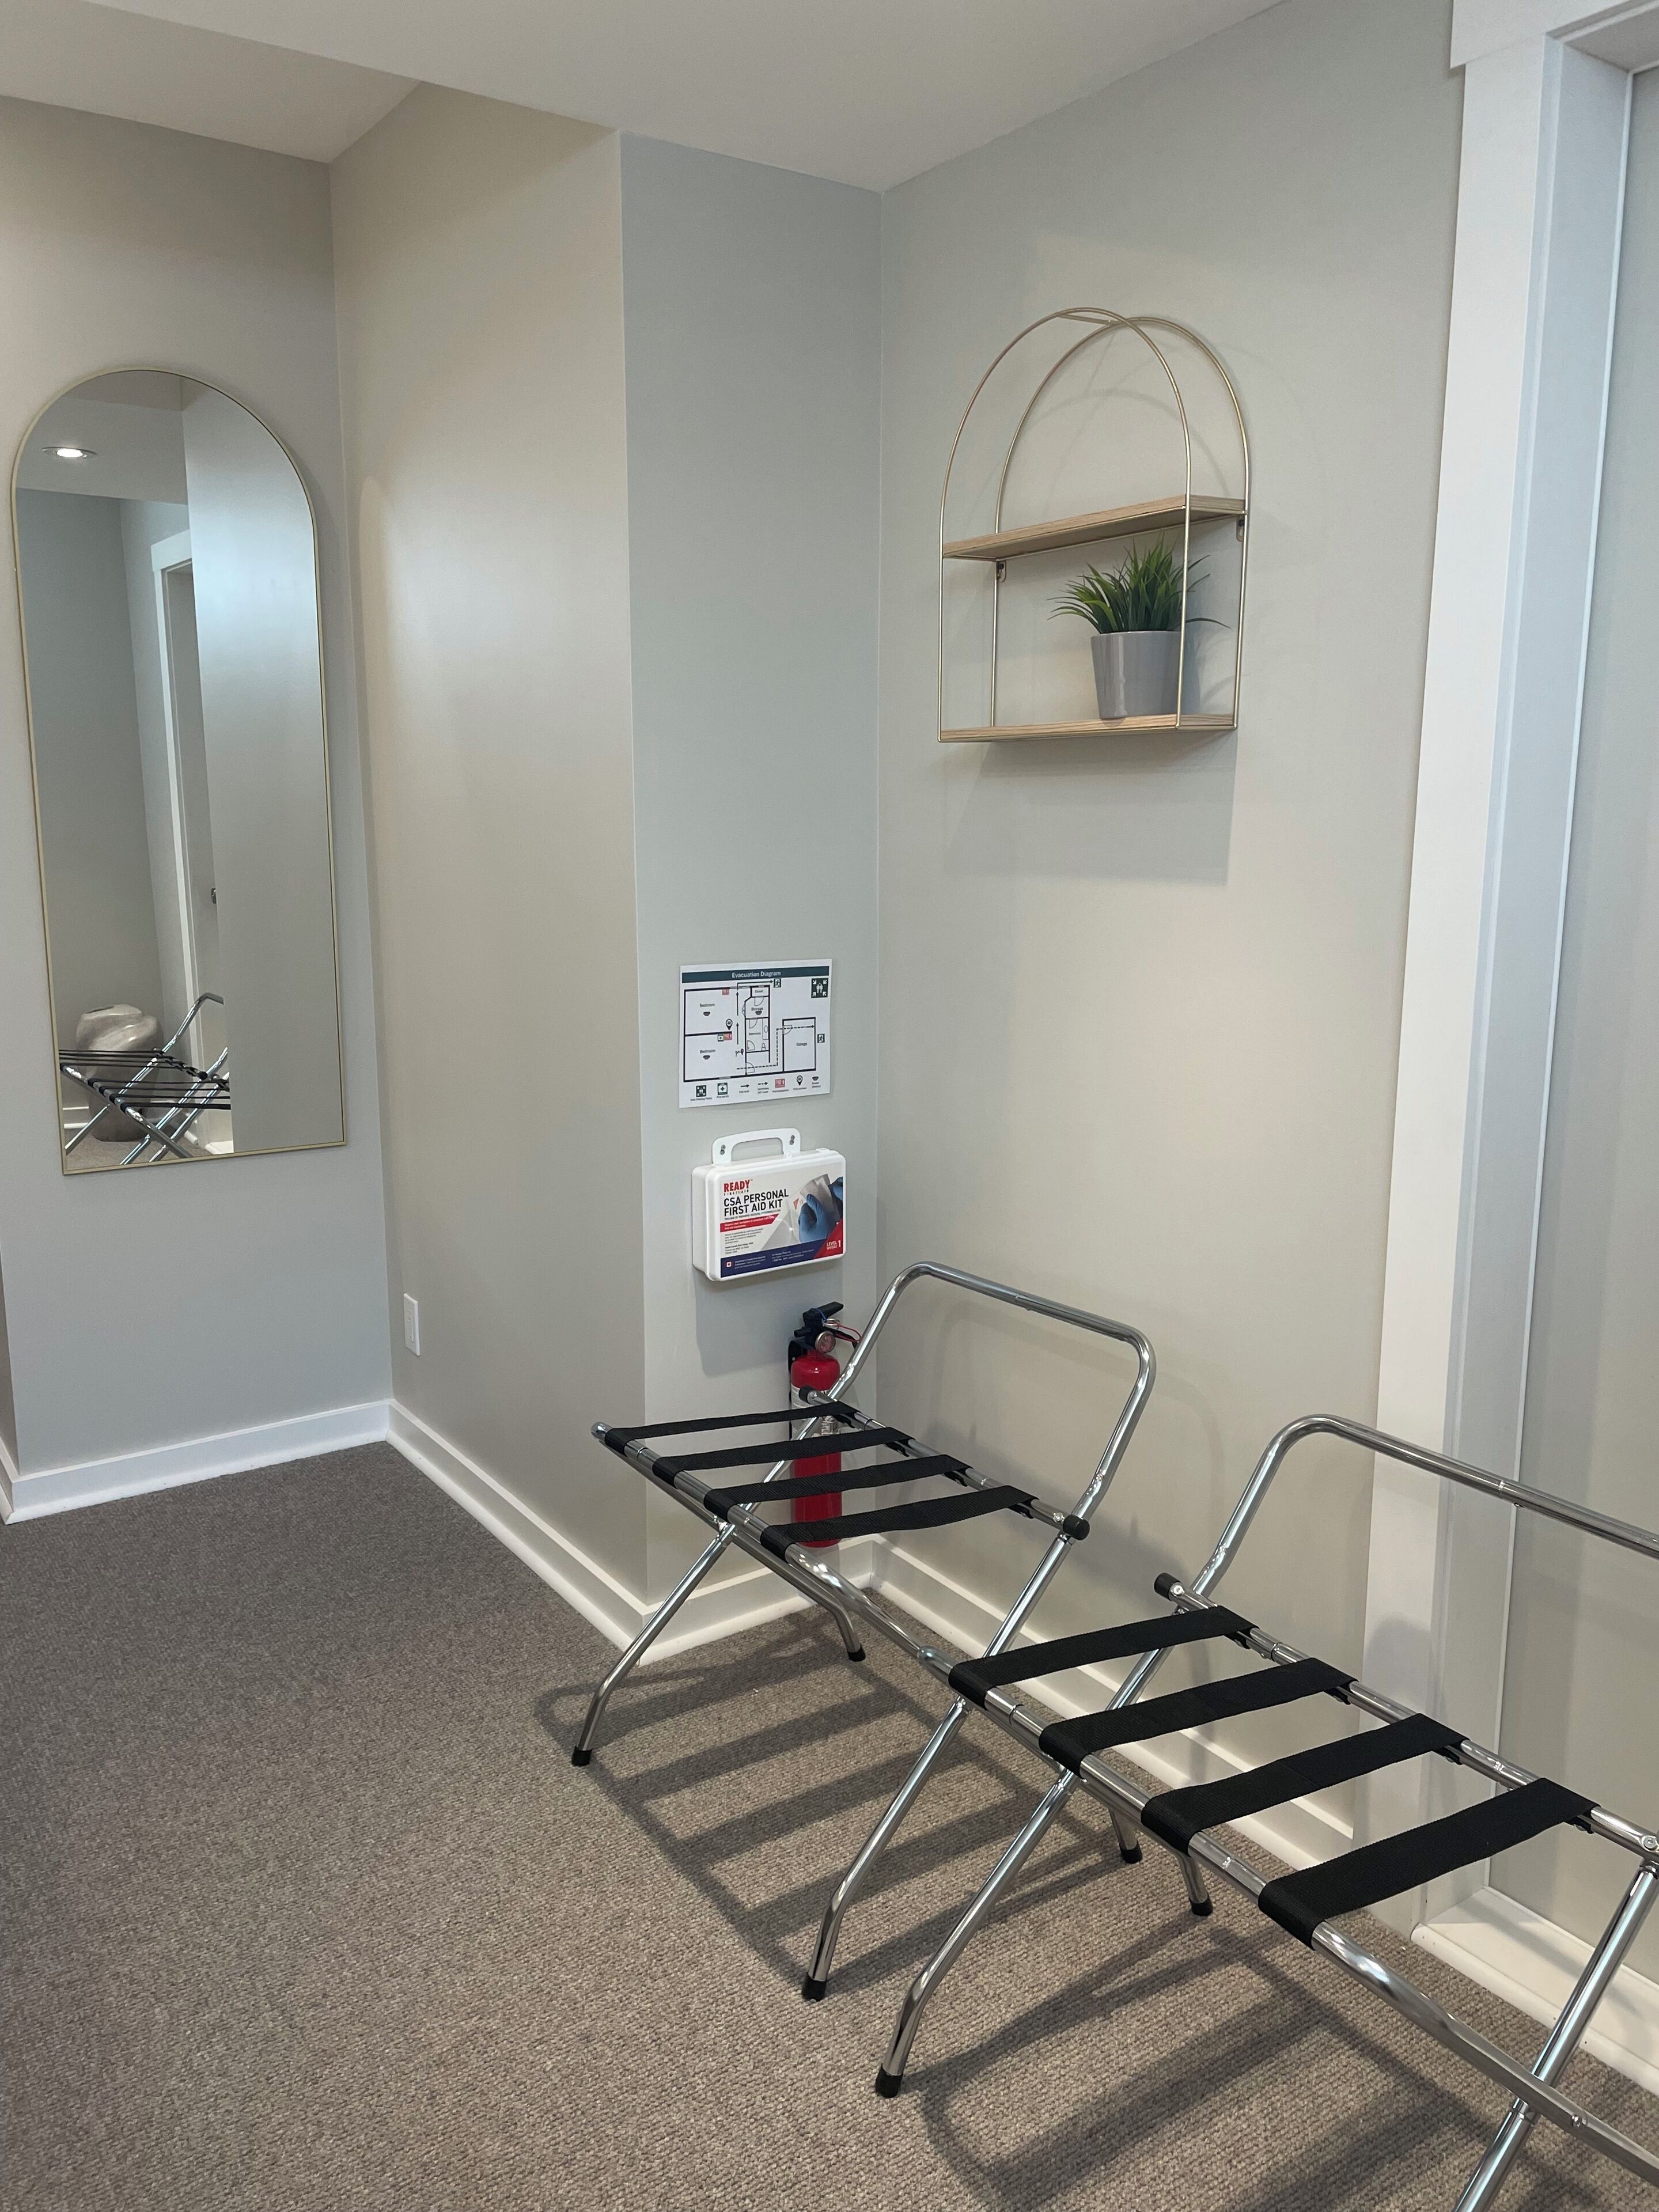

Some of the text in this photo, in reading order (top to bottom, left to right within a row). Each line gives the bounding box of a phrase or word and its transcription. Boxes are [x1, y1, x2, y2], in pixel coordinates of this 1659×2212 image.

[724, 1179, 750, 1192] READY
[724, 1188, 789, 1207] CSA PERSONAL
[724, 1205, 749, 1217] FIRST
[751, 1202, 766, 1212] AID
[768, 1199, 783, 1209] KIT
[838, 1239, 841, 1248] 1
